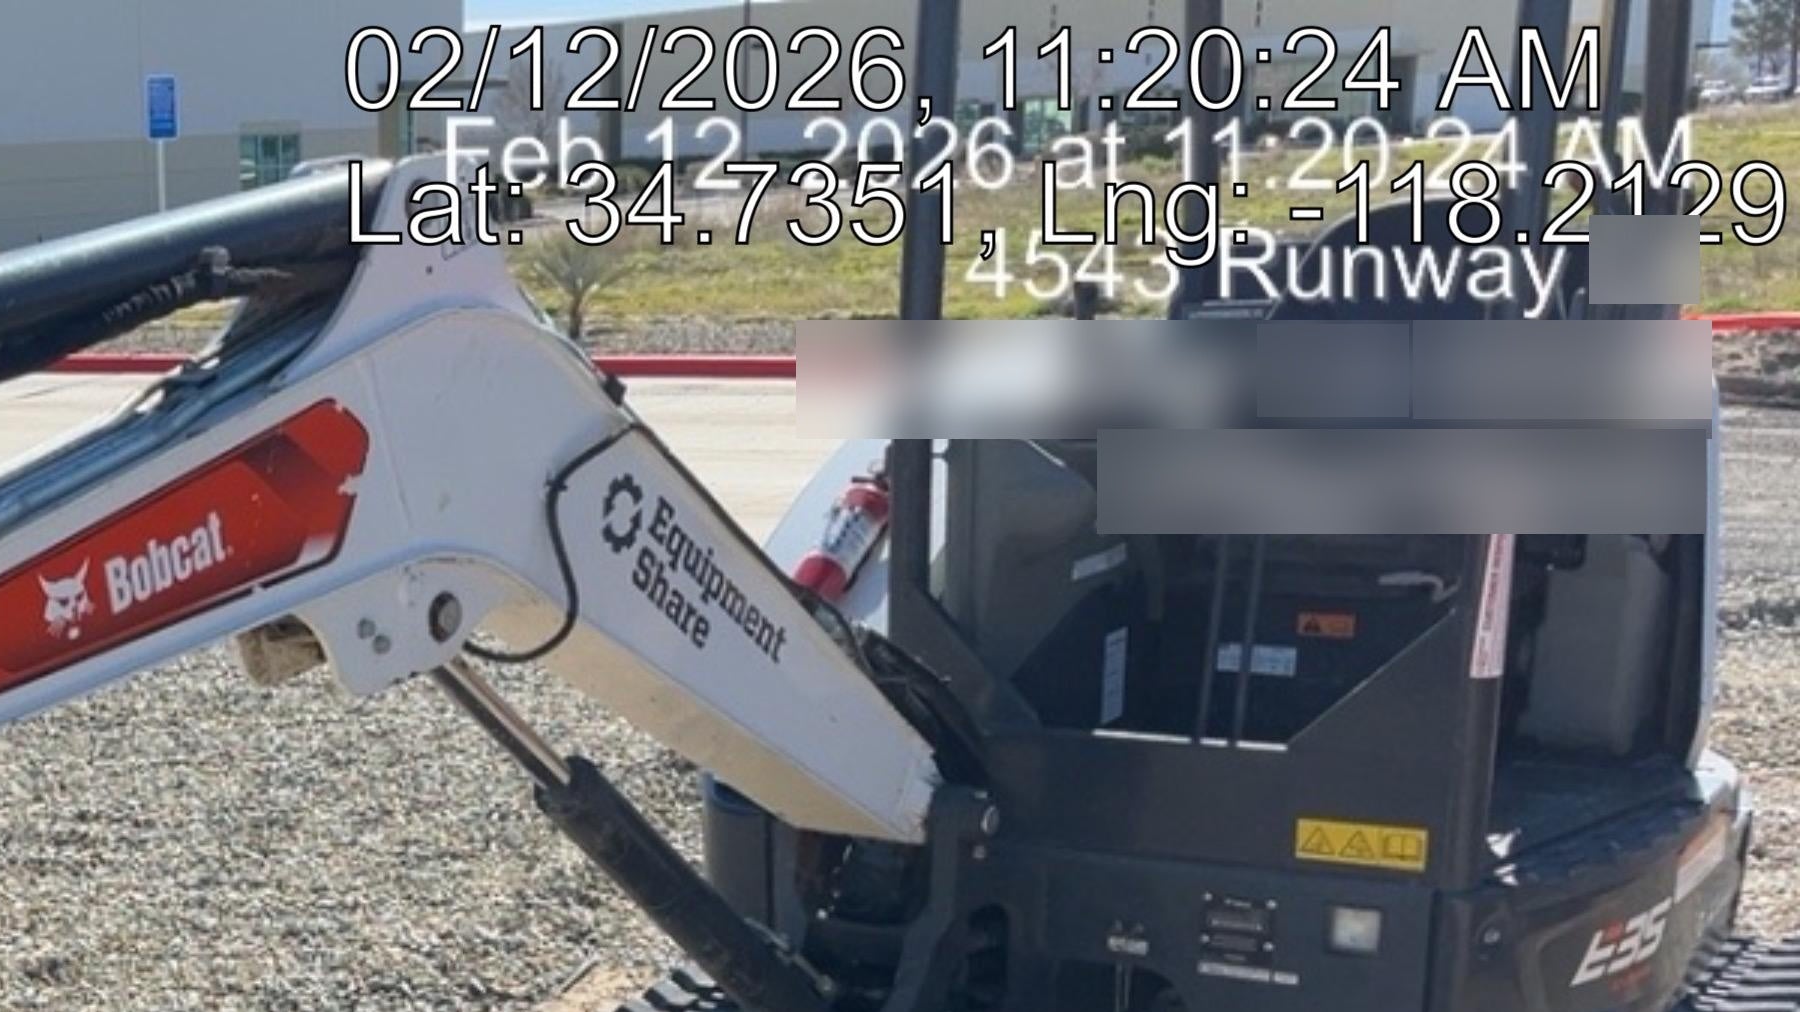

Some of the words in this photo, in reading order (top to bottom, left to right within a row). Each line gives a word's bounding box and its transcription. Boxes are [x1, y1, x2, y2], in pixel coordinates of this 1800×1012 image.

[103, 510, 227, 616] Bobcat
[631, 544, 710, 650] Share
[647, 495, 788, 665] Equipment
